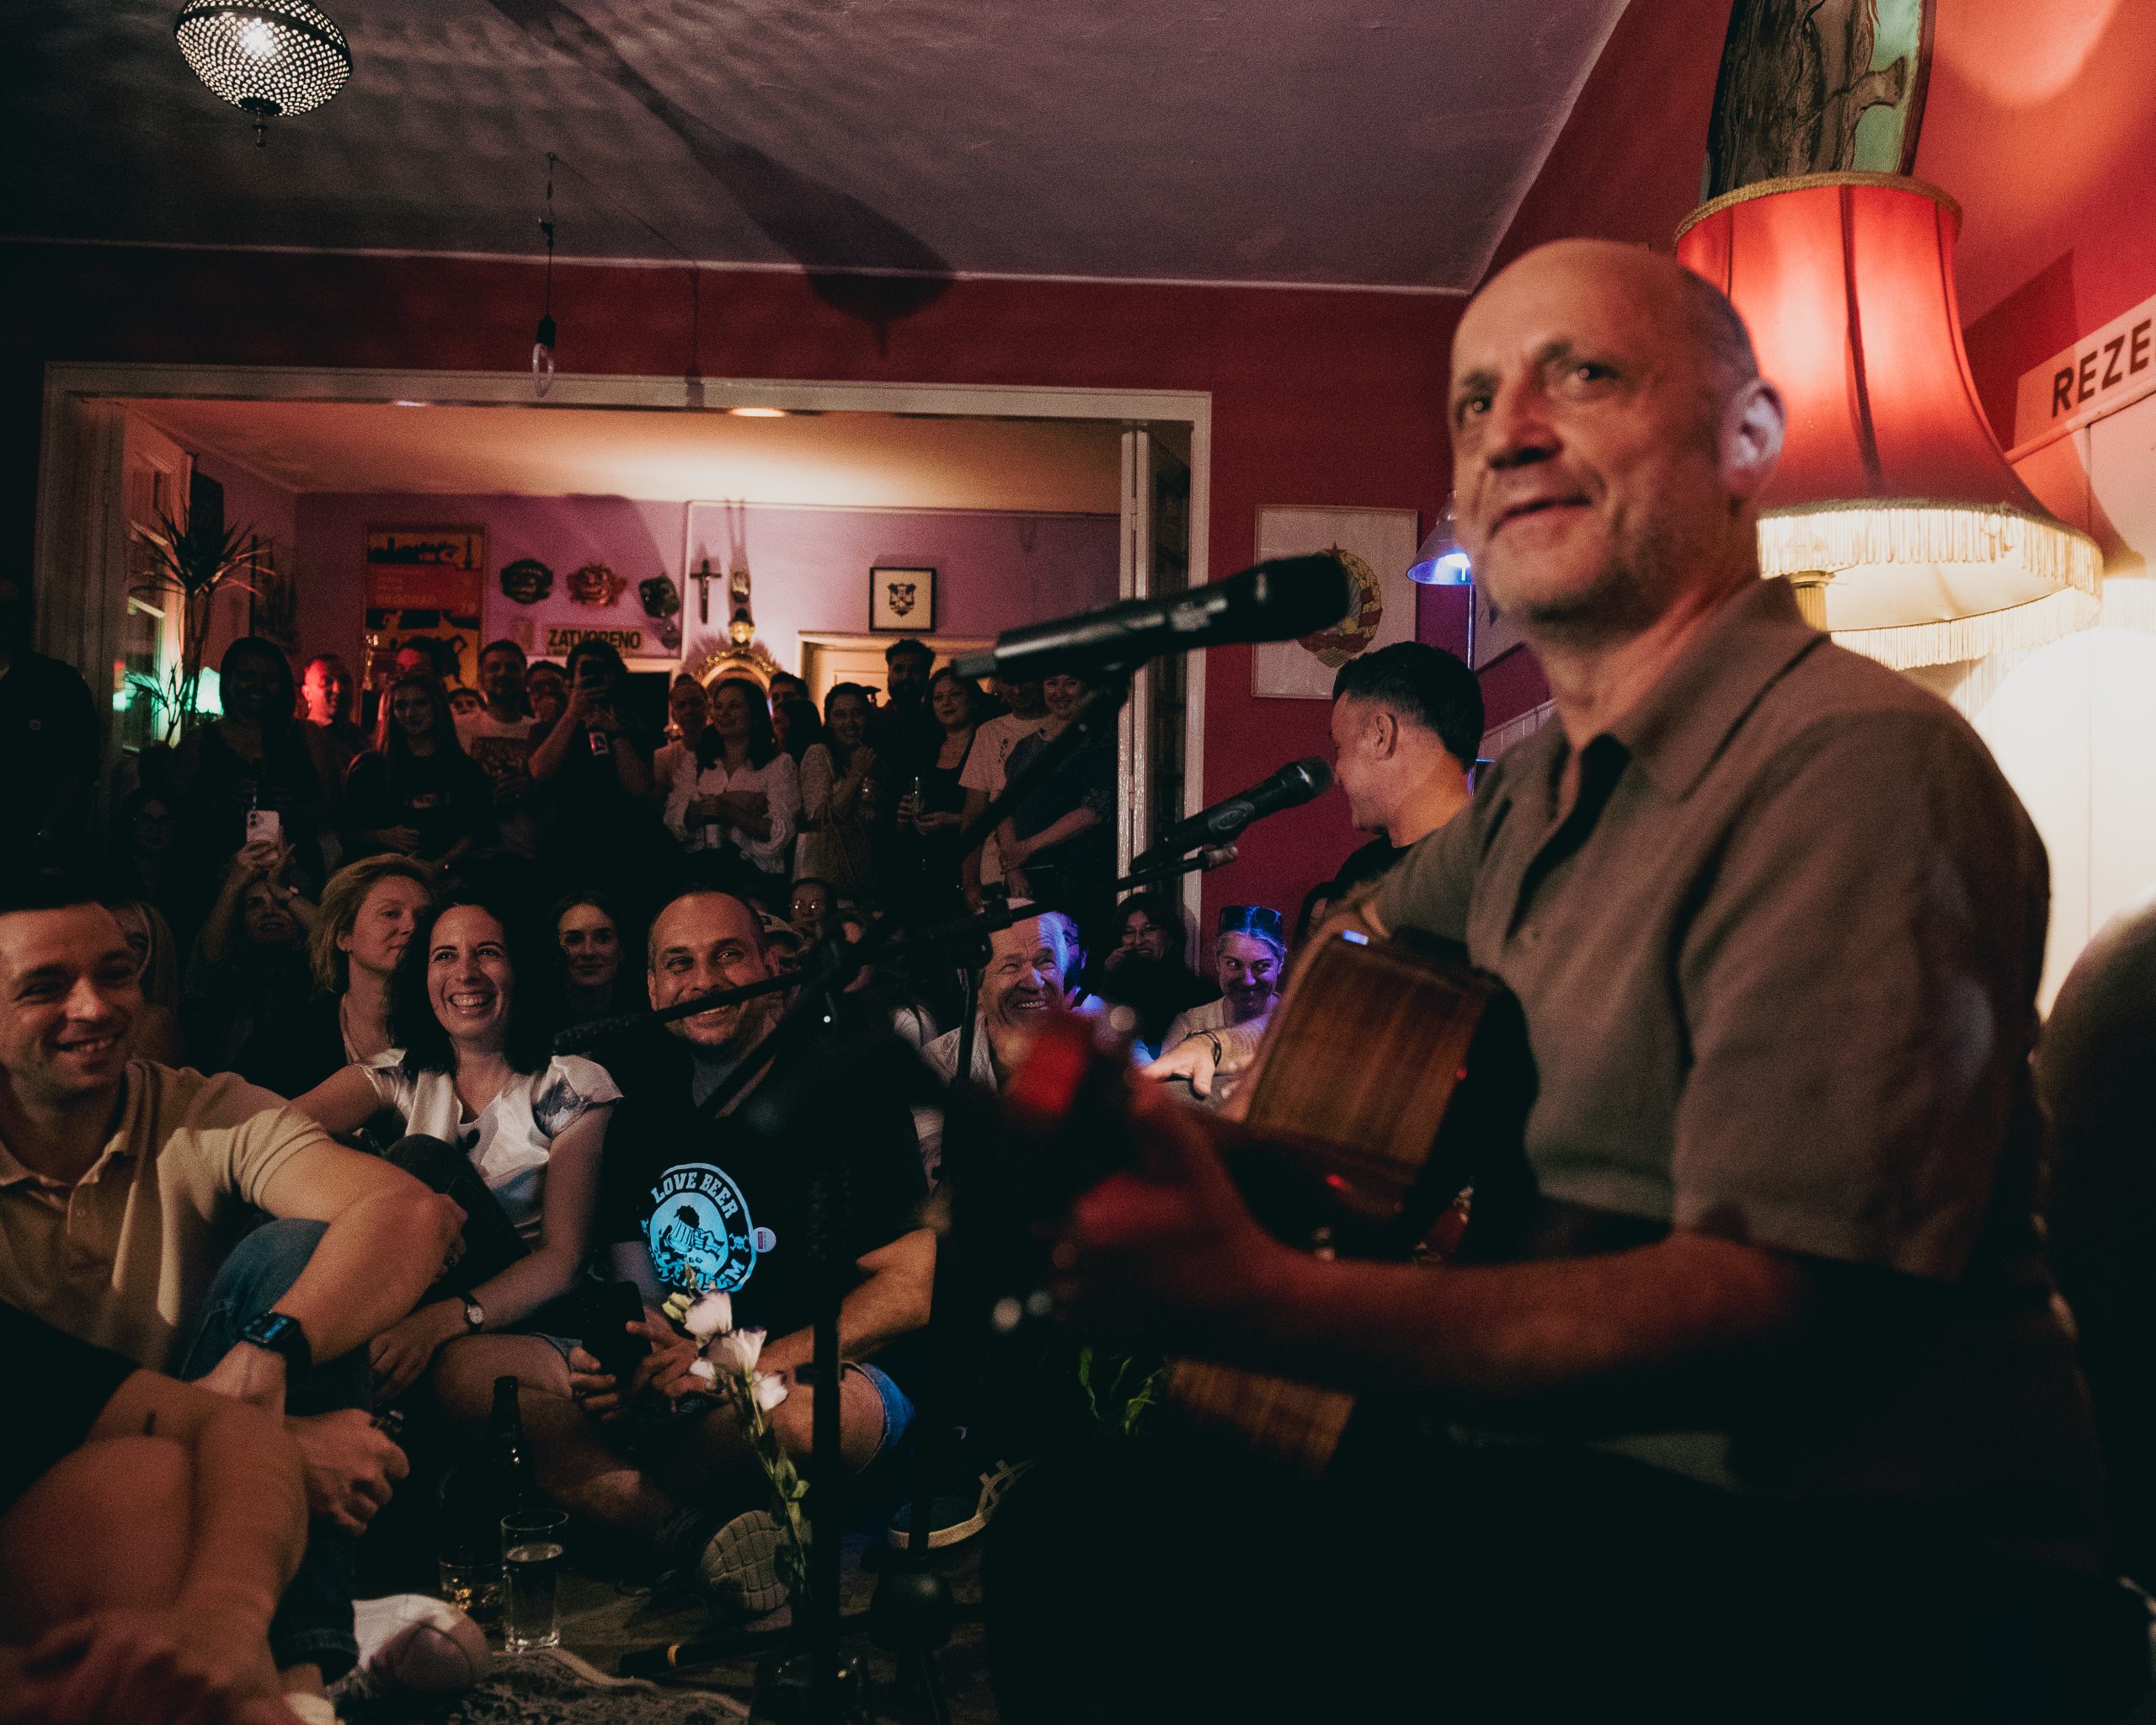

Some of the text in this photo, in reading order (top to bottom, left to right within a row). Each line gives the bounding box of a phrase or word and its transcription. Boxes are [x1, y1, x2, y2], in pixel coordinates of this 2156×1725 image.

[2052, 318, 2153, 419] REZE
[651, 1172, 739, 1219] LOVE BEER
